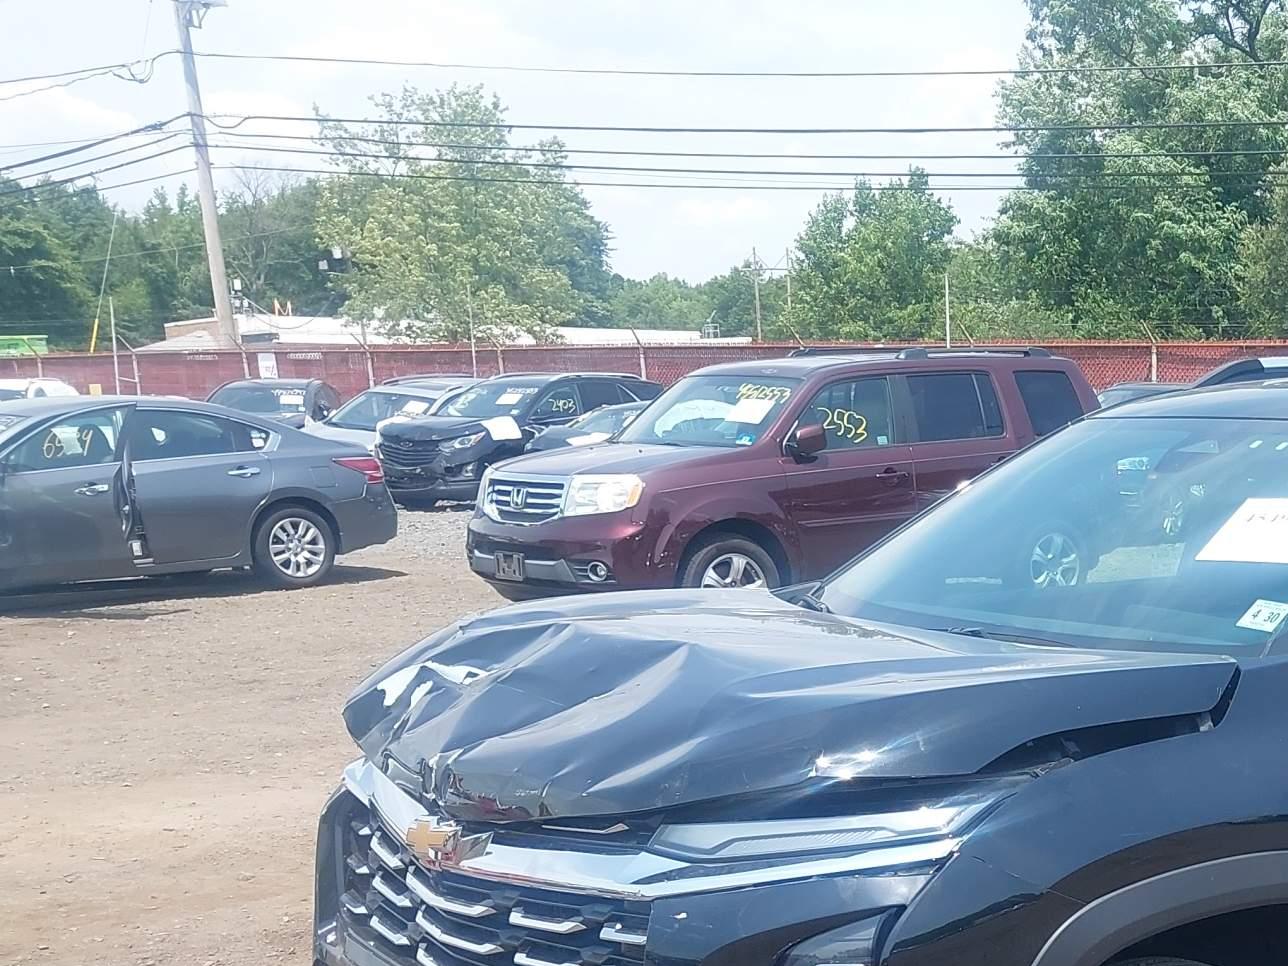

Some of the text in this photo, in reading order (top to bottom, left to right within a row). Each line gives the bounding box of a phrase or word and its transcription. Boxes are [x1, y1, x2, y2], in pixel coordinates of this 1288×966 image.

[547, 398, 577, 414] 2403
[816, 408, 868, 444] 2553
[1263, 611, 1281, 624] 30
